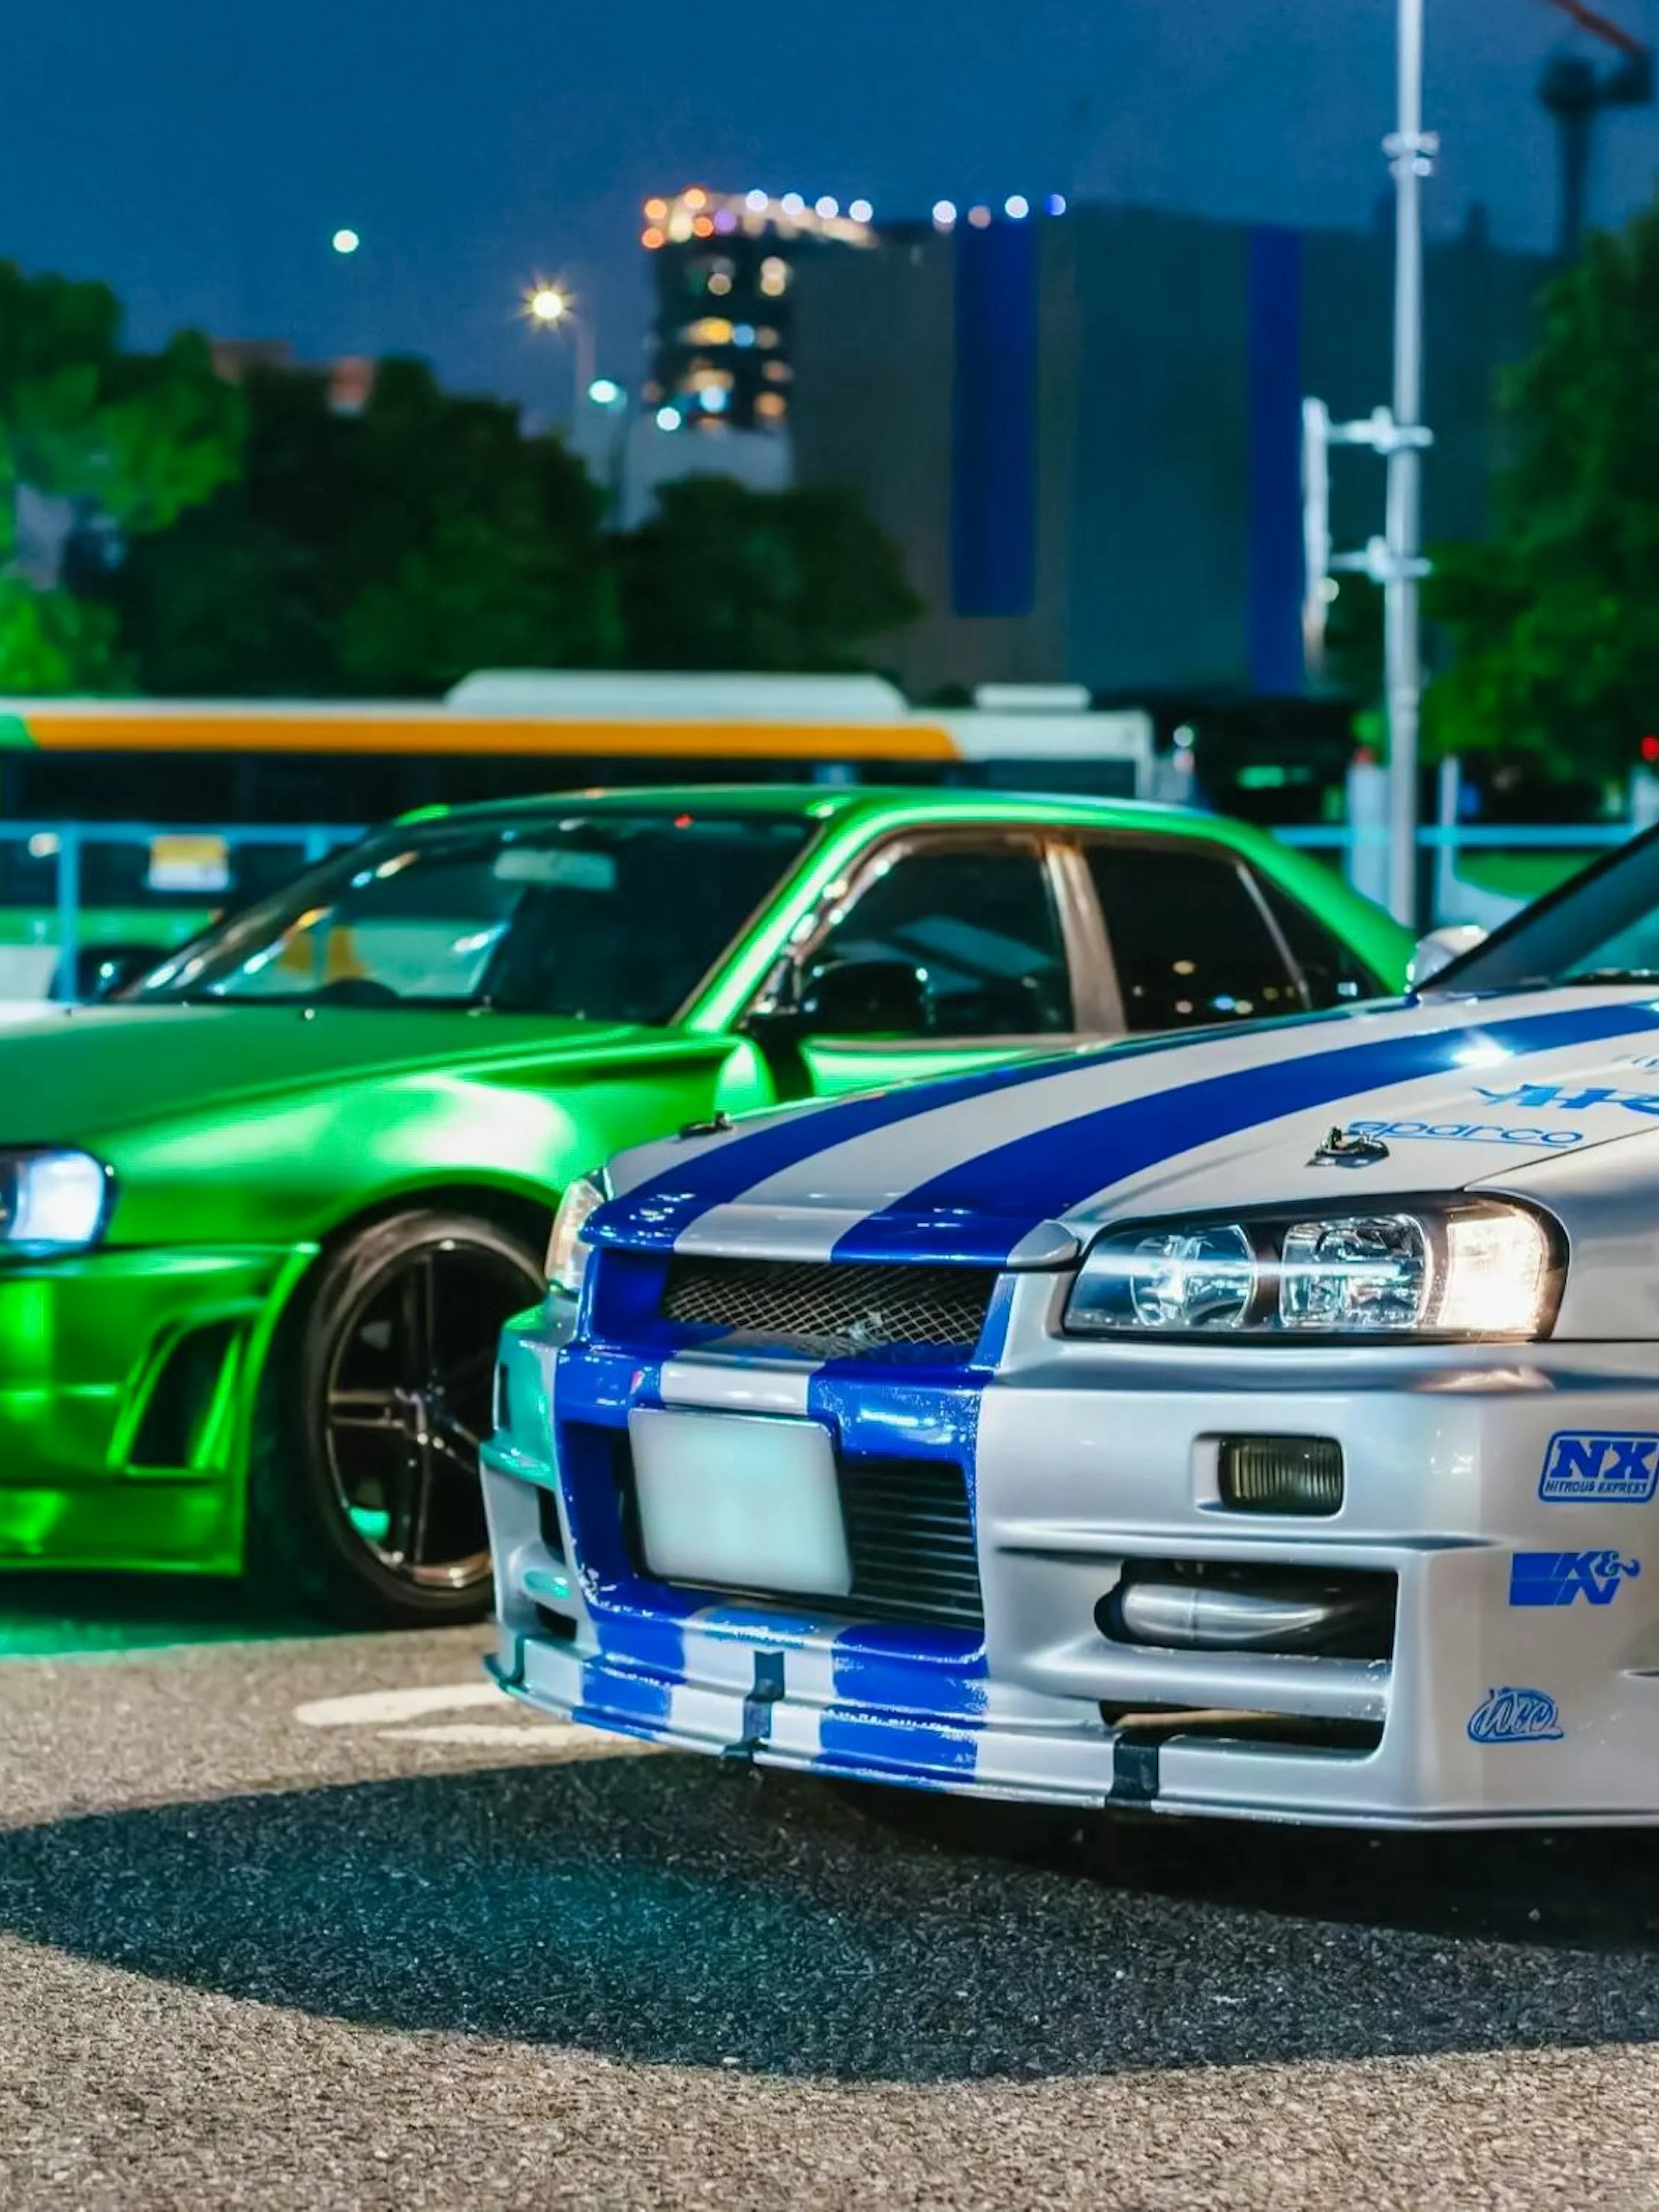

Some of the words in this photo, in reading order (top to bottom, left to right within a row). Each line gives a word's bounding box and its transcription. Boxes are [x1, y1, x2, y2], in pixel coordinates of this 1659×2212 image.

[1549, 1440, 1658, 1479] NX
[1544, 1480, 1595, 1493] NITROUS
[1597, 1481, 1647, 1494] EXPRESS
